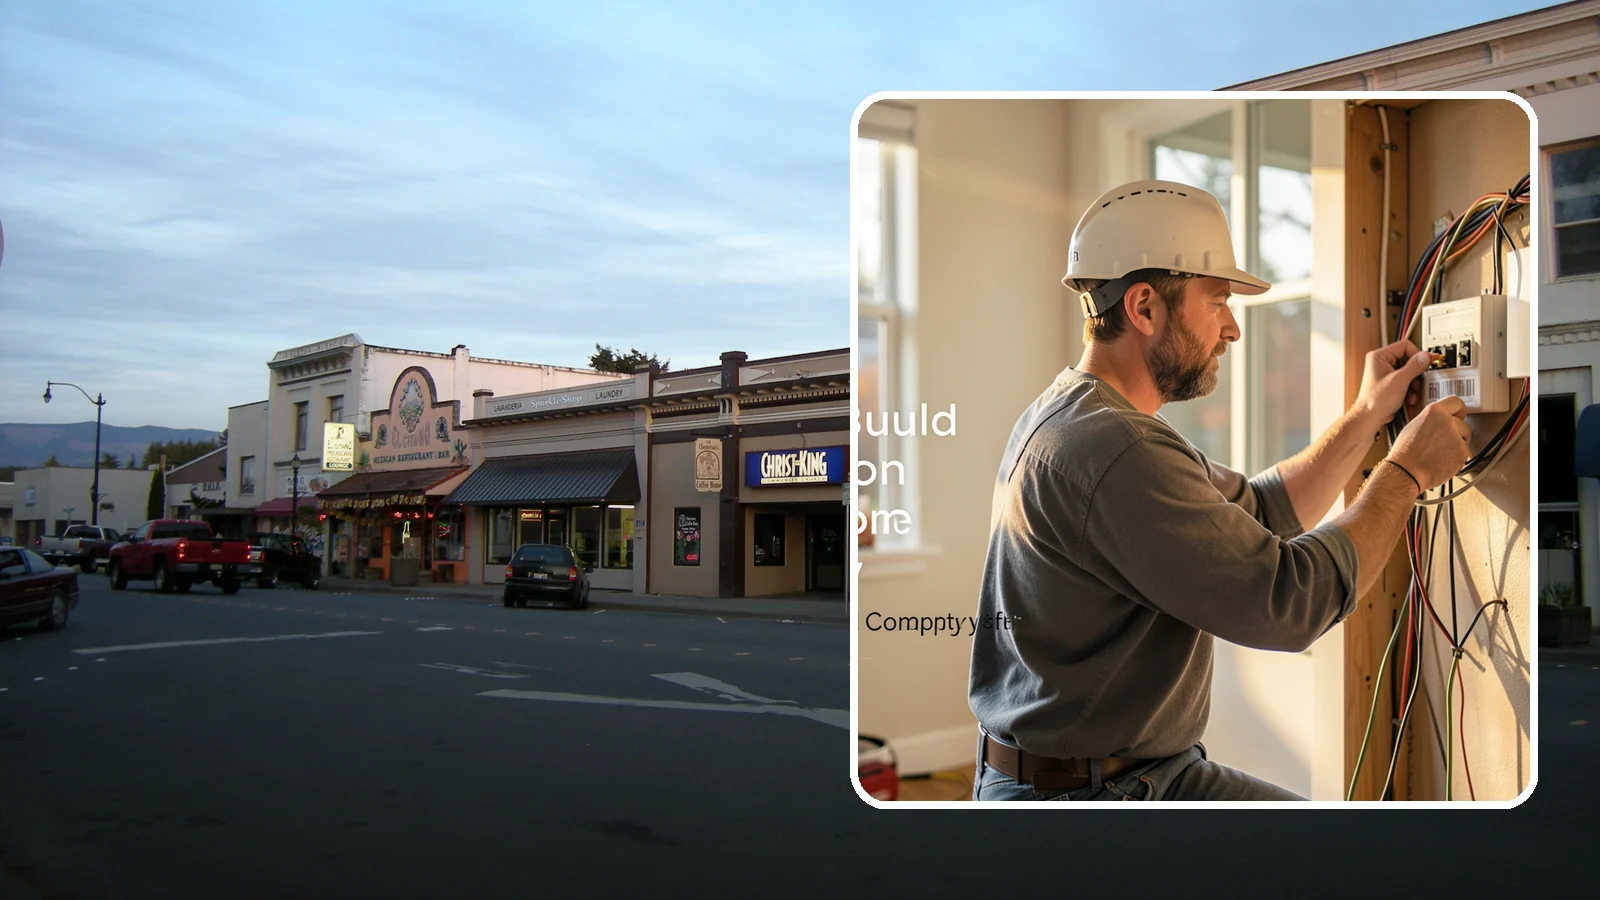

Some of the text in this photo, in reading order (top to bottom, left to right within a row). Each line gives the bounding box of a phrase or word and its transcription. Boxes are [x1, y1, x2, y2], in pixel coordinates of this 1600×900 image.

[562, 394, 583, 405] Shop
[595, 389, 624, 400] LAUNDRY
[397, 451, 434, 462] RESTAURANT
[438, 450, 450, 459] BAR
[761, 450, 827, 478] CHRIST KING
